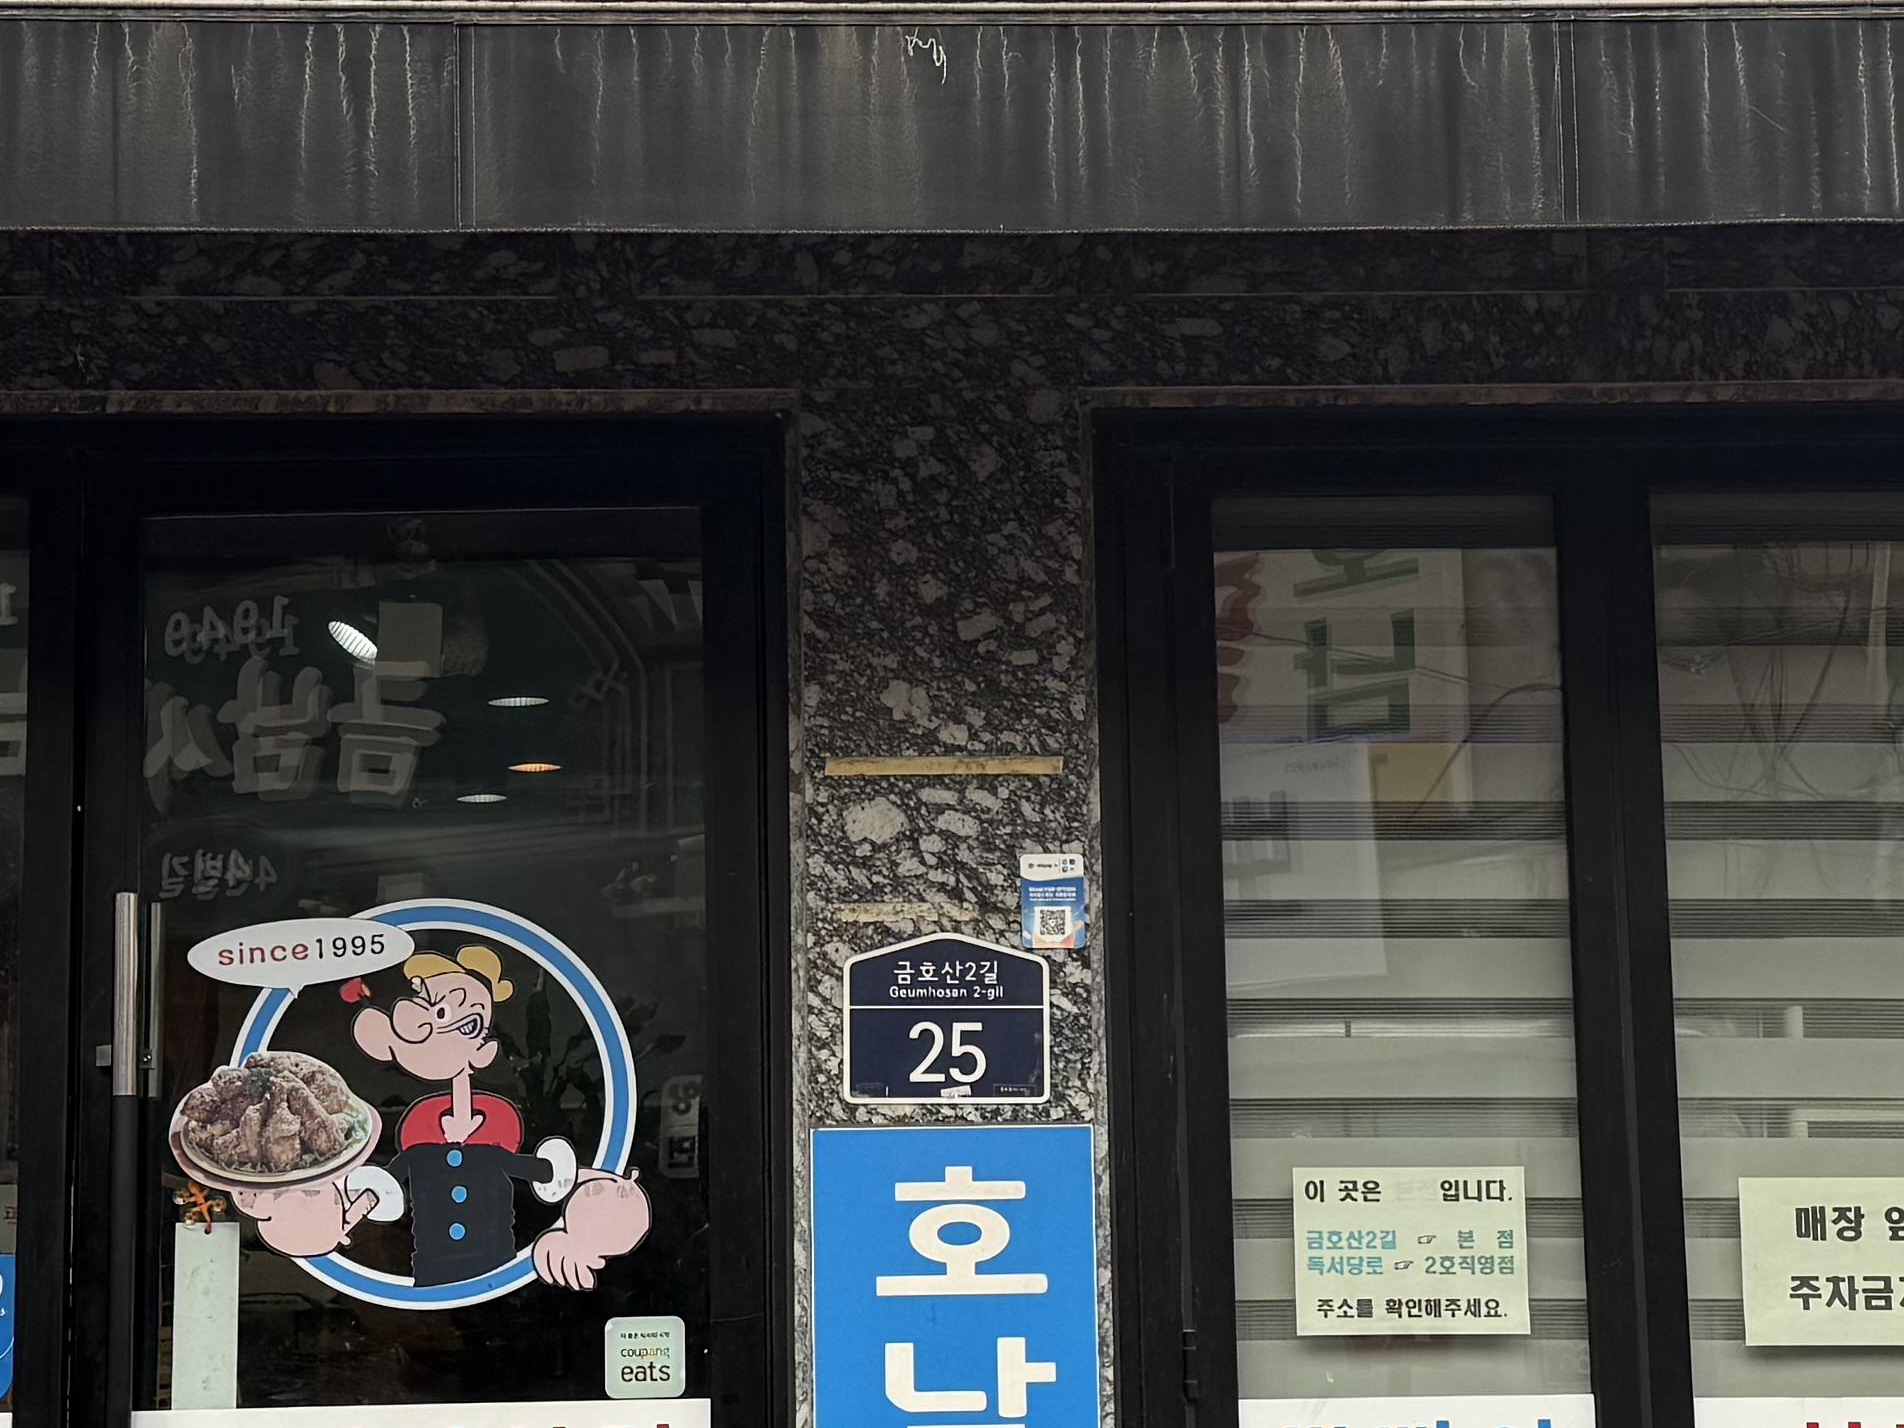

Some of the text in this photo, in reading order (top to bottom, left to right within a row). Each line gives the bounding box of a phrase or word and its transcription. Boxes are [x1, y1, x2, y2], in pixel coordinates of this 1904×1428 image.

[217, 934, 385, 966] since1995
[894, 960, 998, 985] 금호산2길
[889, 986, 967, 998] Geumhosan
[909, 1021, 987, 1083] 25
[1304, 1180, 1325, 1203] 이
[1338, 1180, 1382, 1203] 곳은
[1440, 1179, 1513, 1203] 입니다.
[1794, 1205, 1864, 1244] 매장
[1306, 1230, 1397, 1250] 금호산2길
[1307, 1255, 1515, 1276] 독서당로 2호직영점
[1316, 1298, 1508, 1319] 주소를 확인해주세요.
[620, 1347, 671, 1359] coupang
[621, 1361, 671, 1382] eats
